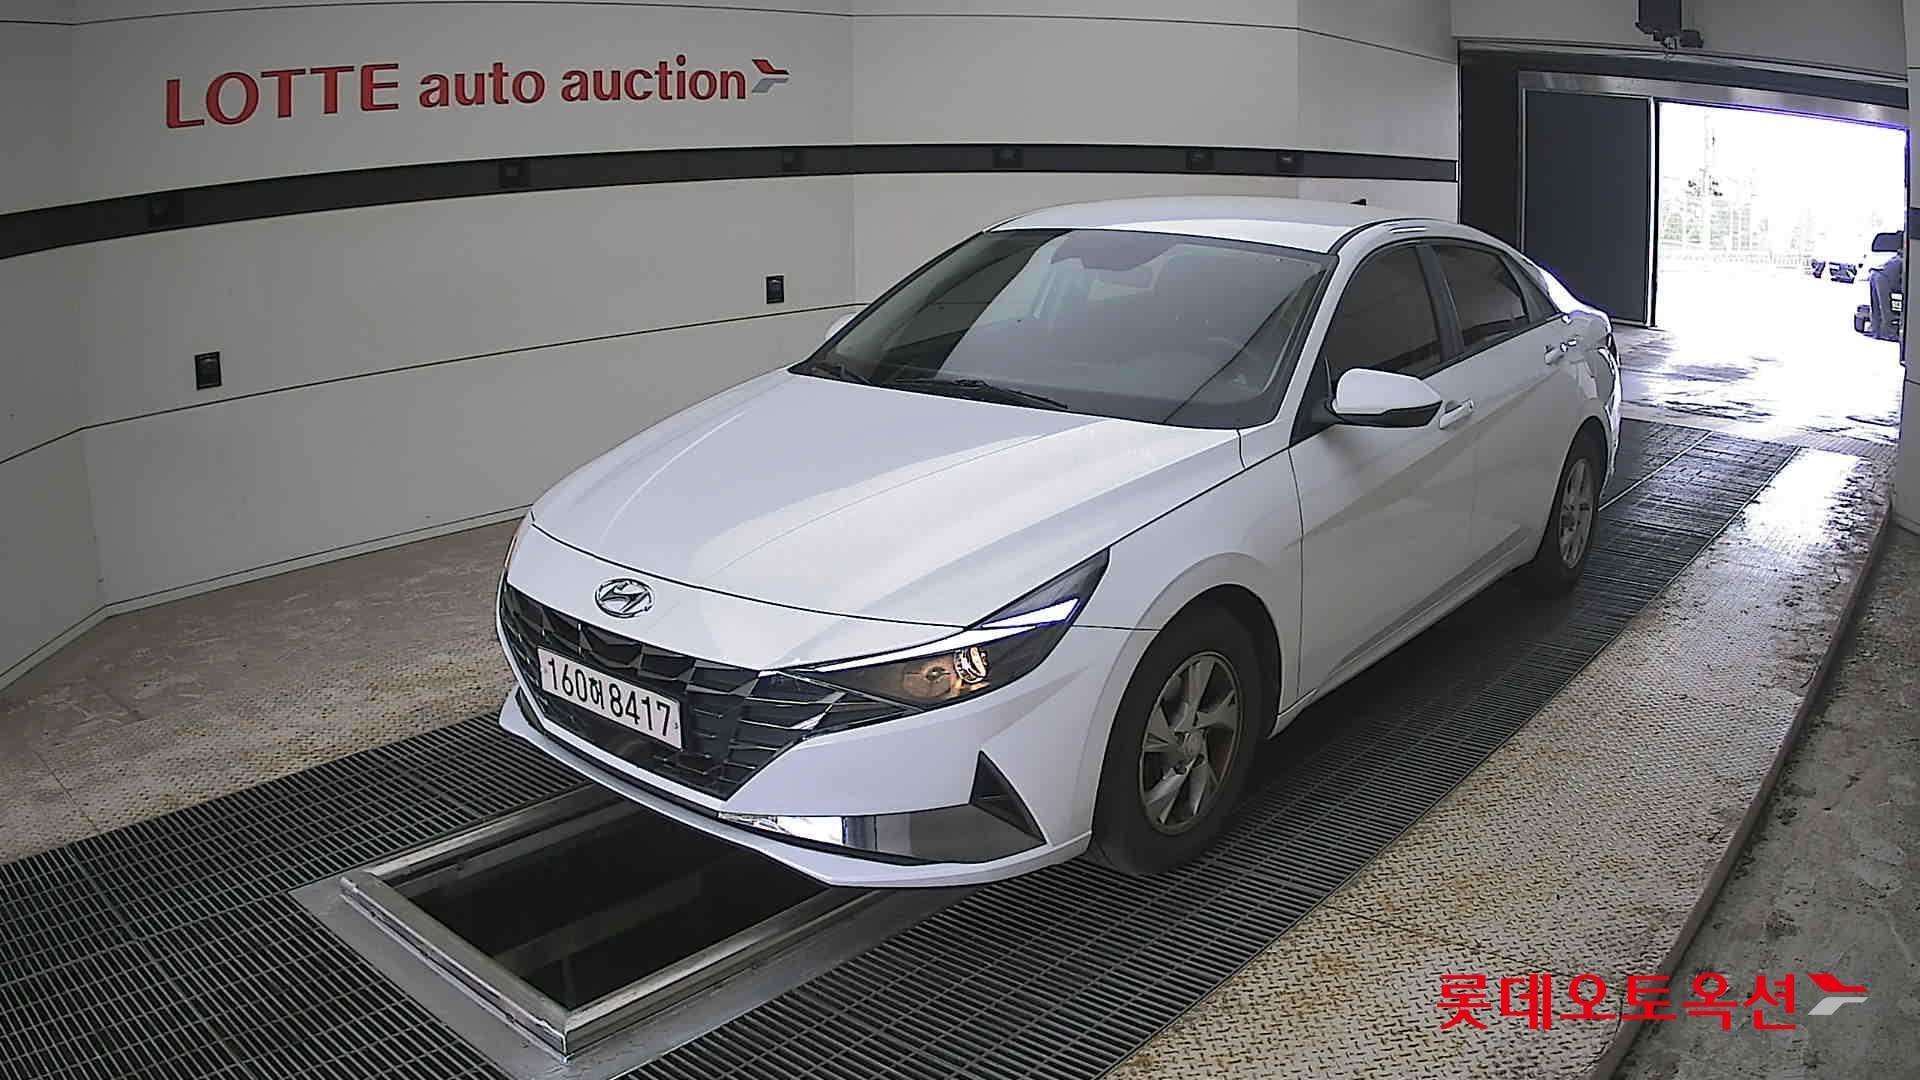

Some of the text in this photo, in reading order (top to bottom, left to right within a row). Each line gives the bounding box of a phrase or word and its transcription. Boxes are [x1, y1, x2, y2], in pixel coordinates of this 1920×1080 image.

[165, 55, 747, 129] LOTTE auto auction
